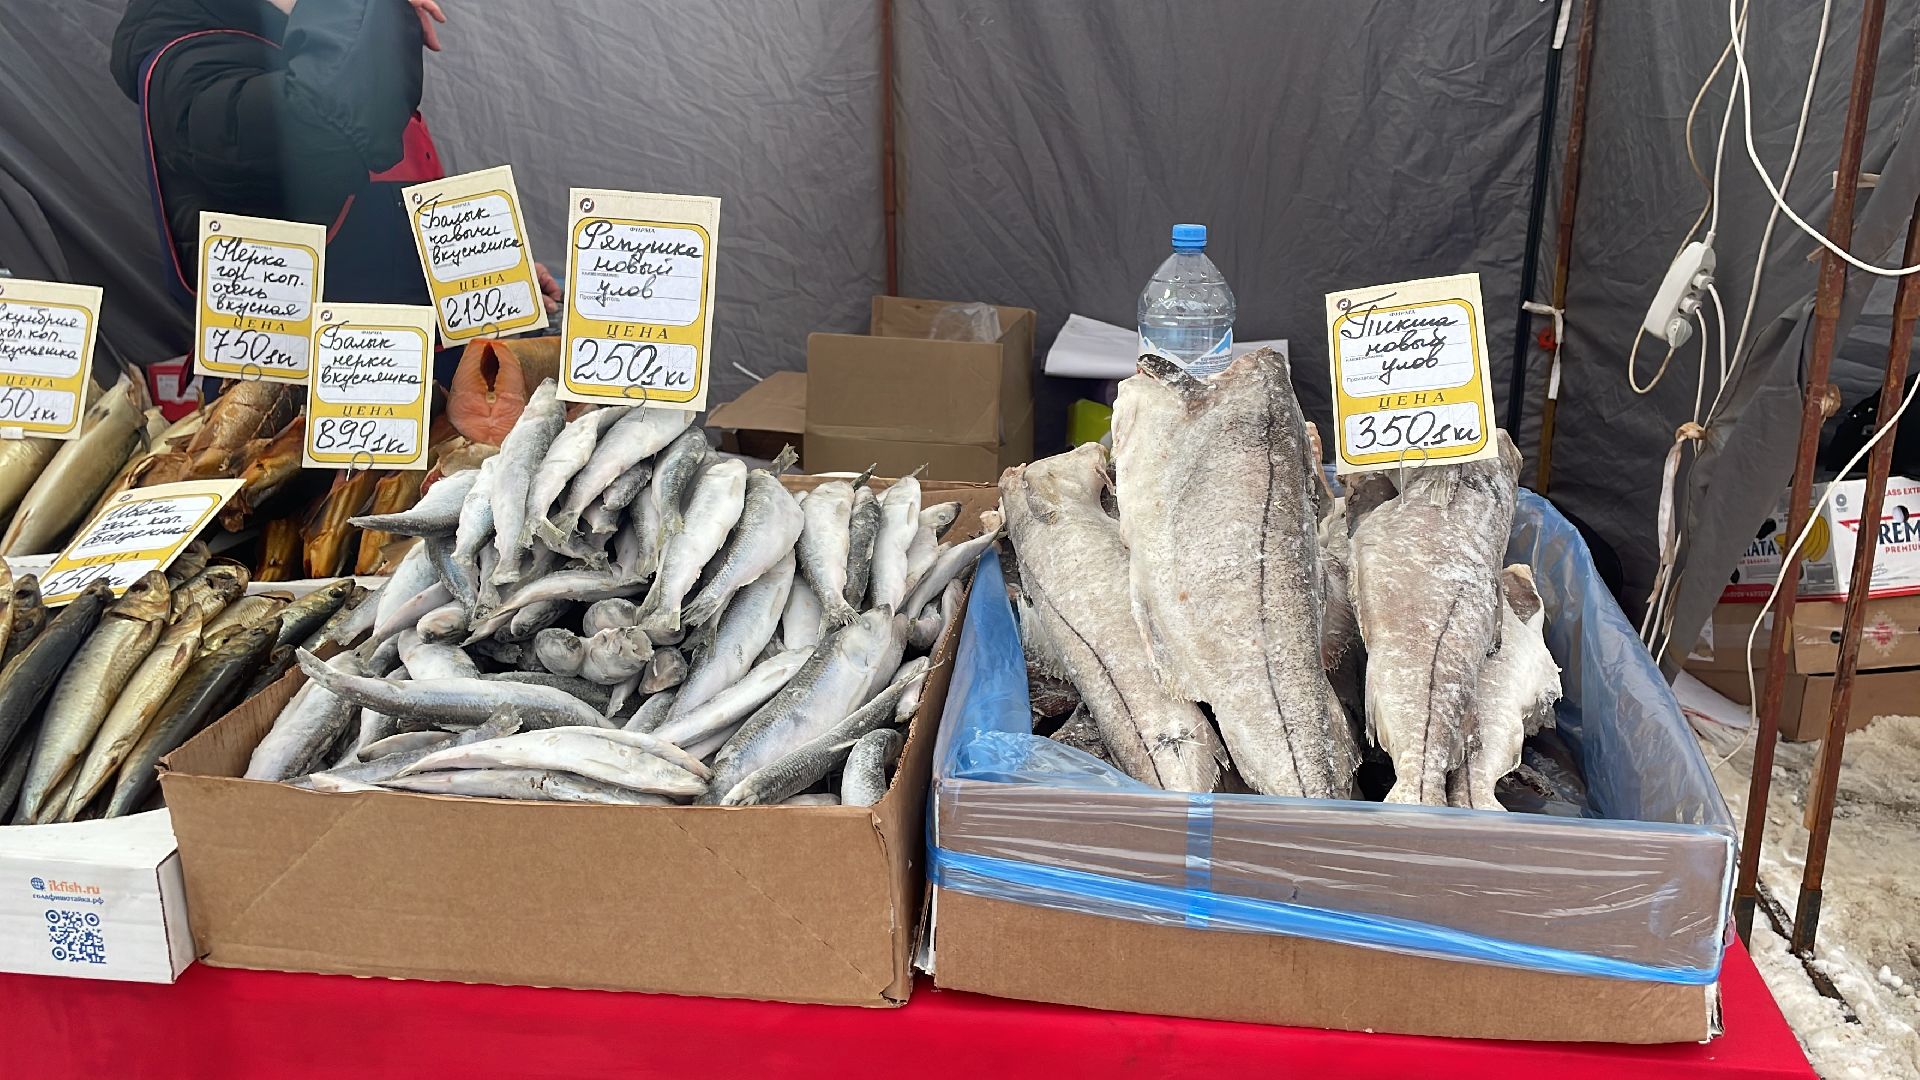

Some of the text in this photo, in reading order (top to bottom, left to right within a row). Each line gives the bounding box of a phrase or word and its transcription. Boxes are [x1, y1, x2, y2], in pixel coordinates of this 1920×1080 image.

[417, 193, 490, 229] Балык
[432, 237, 524, 267] вкусняшка
[575, 220, 703, 262] Ряпушка
[593, 254, 673, 276] новый
[212, 282, 267, 299] очень
[263, 271, 305, 287] коп.
[459, 273, 505, 292] ЦЕНА
[596, 273, 657, 308] улов
[216, 294, 301, 319] вкусная
[446, 288, 501, 328] 2130
[1341, 292, 1458, 339] Пикша
[234, 317, 285, 331] ЦЕНА
[320, 320, 395, 350] Балык
[606, 324, 669, 340] ЦЕНА
[213, 329, 270, 362] 750
[1366, 329, 1447, 356] новый
[333, 353, 398, 375] нерки
[573, 338, 657, 382] 250
[1379, 343, 1444, 385] улов
[6, 376, 54, 388] ЦЕНА
[321, 365, 423, 392] вкусняшка
[342, 405, 394, 417] ЦЕНА
[1378, 392, 1445, 409] ЦЕНА
[316, 419, 376, 449] 899
[83, 553, 139, 567] ЦЕНА
[1885, 543, 1920, 554] PREMIU
[48, 879, 101, 895] ikfish.ru
